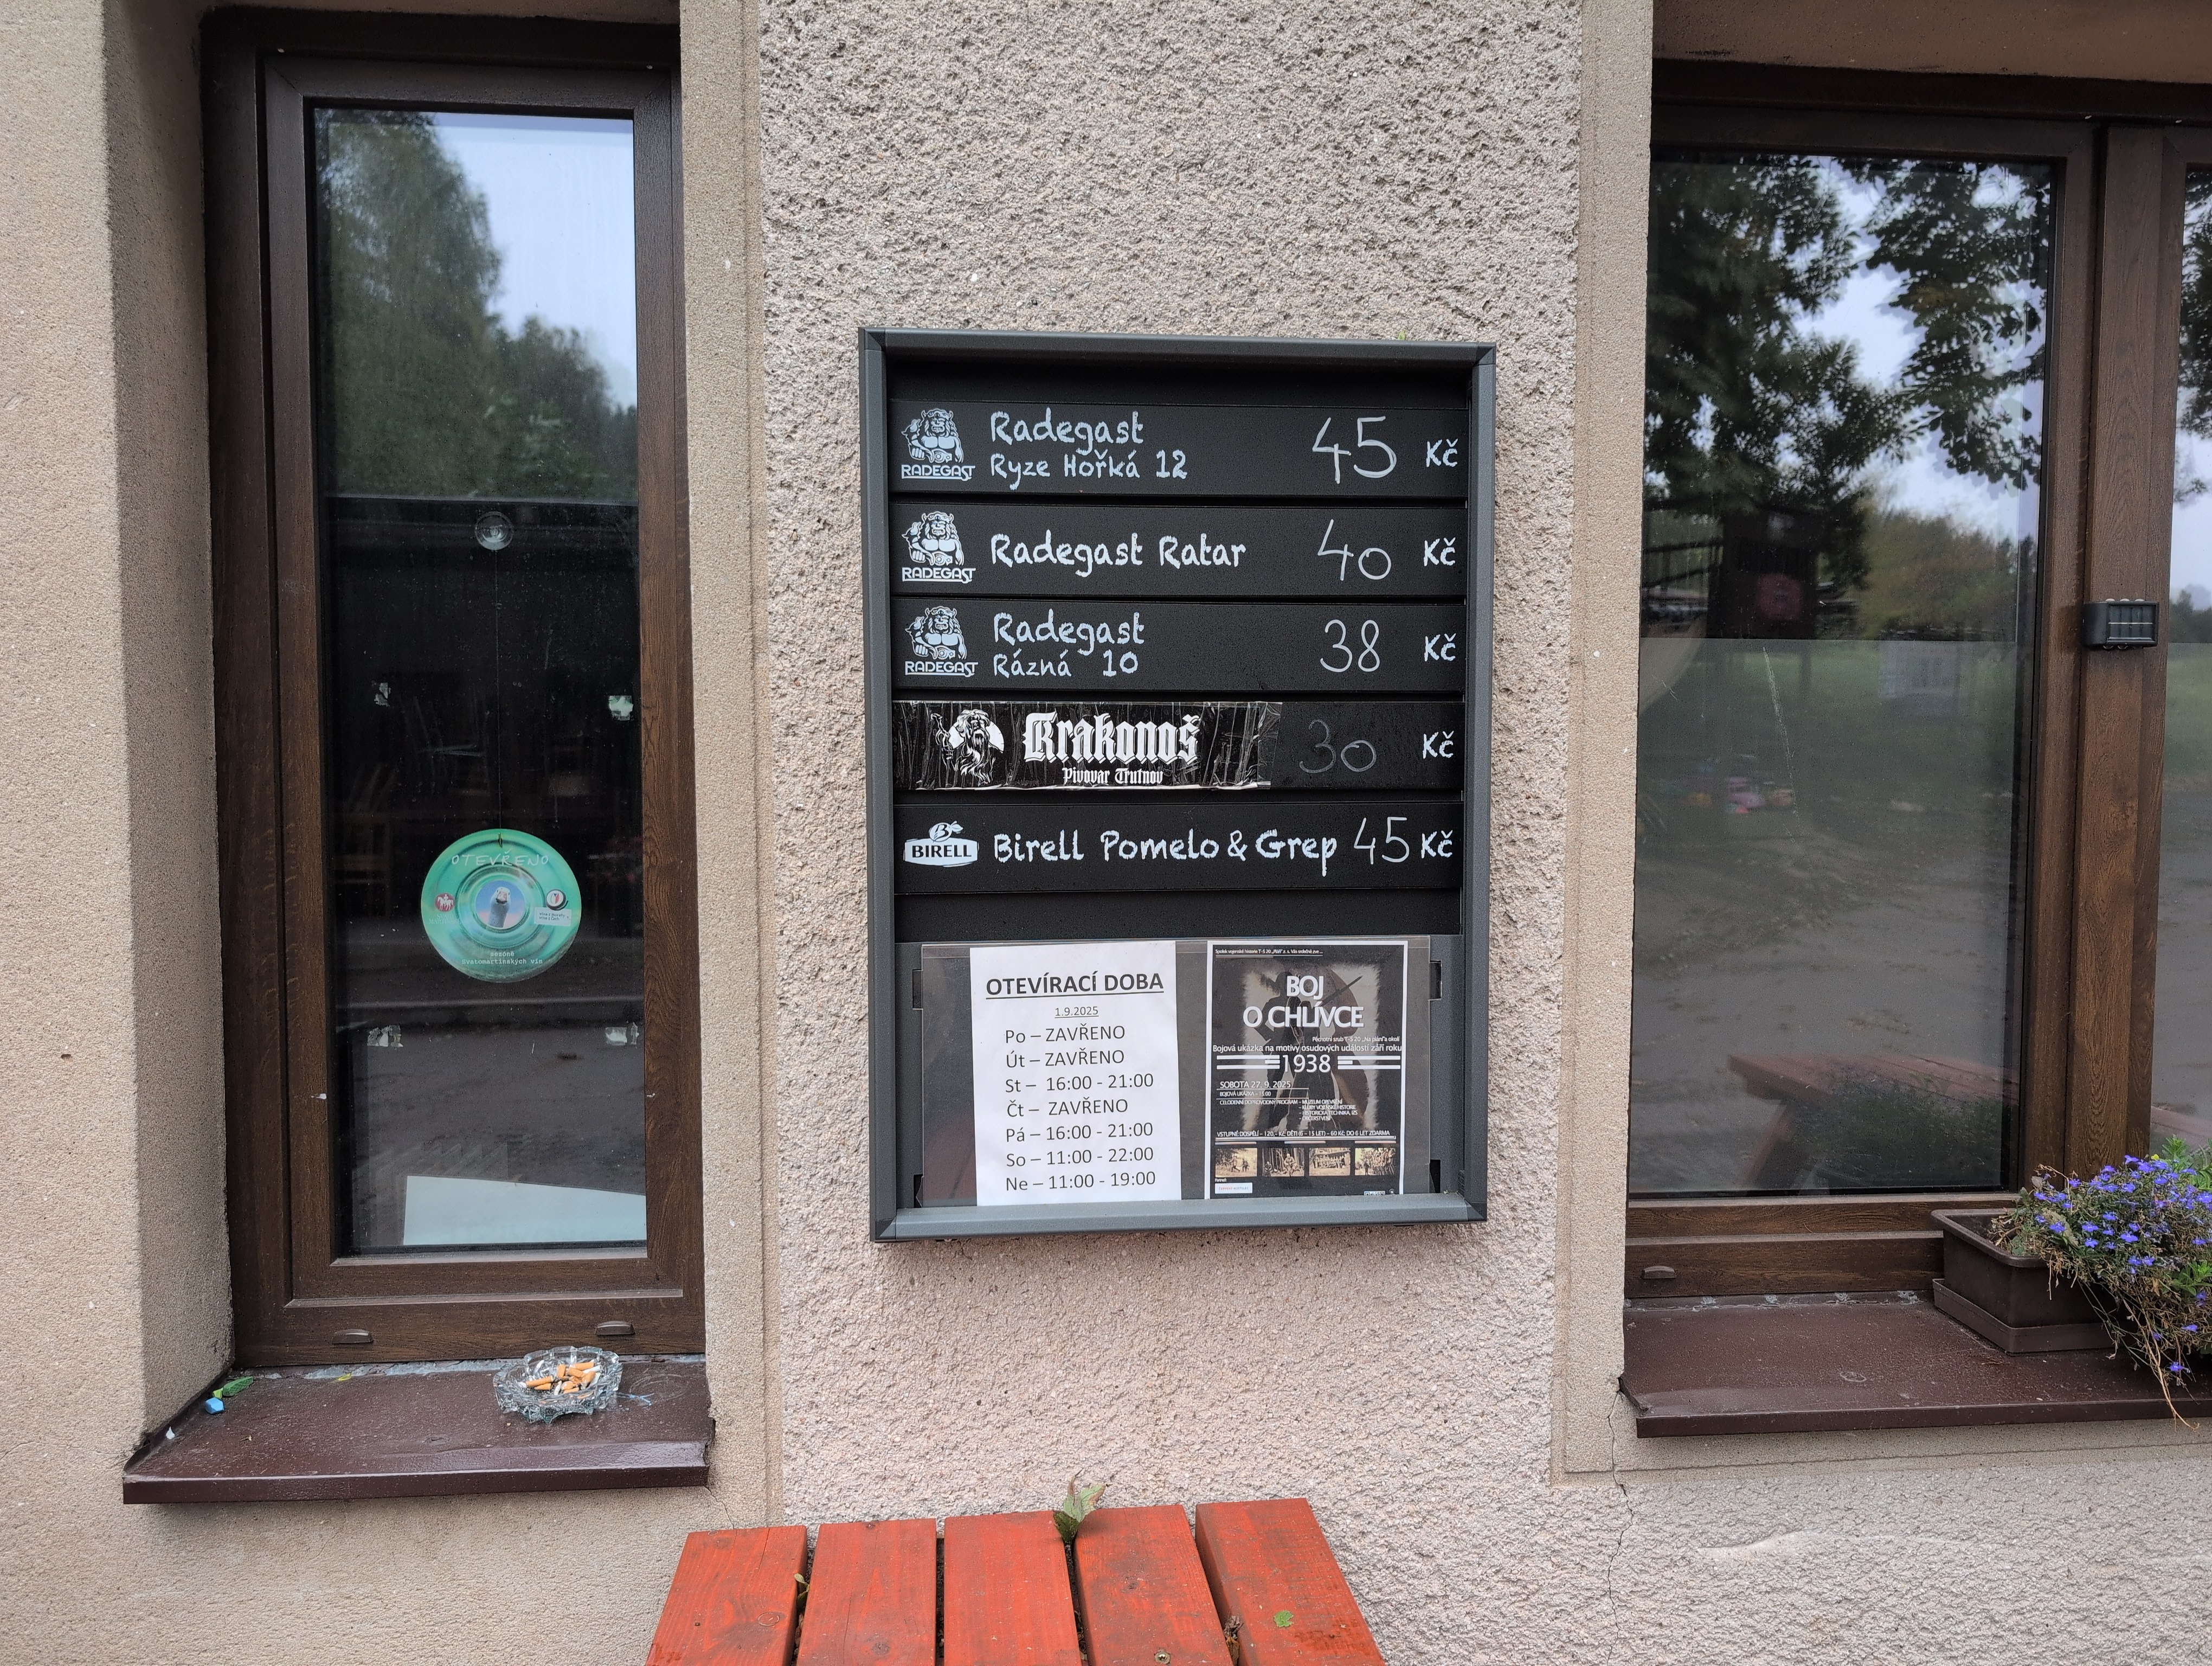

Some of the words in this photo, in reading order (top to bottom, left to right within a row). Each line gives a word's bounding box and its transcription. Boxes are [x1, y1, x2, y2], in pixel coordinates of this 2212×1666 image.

[991, 408, 1143, 456] Radegast
[1313, 416, 1396, 484] 45
[1426, 439, 1457, 468] Kč
[901, 465, 975, 480] RADEGAST
[991, 455, 1050, 490] Ryze
[1064, 448, 1141, 478] Hořká
[1156, 453, 1187, 478] 12
[991, 529, 1143, 577] Radegast
[1159, 532, 1246, 569] Ratar
[1317, 519, 1391, 581] 40
[1424, 538, 1455, 567] Kč
[902, 568, 976, 584] RADEGAST
[994, 610, 1144, 655] Radegast
[1320, 619, 1379, 672] 38
[1425, 634, 1456, 662] Kč
[905, 661, 978, 676] RADEGAST
[994, 651, 1071, 677] Rázná
[1103, 651, 1138, 676] 10
[1024, 711, 1201, 764] Krakonoš
[1300, 719, 1376, 773] 30
[1423, 732, 1454, 759] Kč
[1063, 767, 1109, 786] Pivovar
[1115, 767, 1163, 785] Trutnov
[912, 844, 972, 858] BIRELL
[994, 830, 1084, 862] Birell
[1102, 830, 1219, 861] Pomelo
[1229, 830, 1246, 860] &
[1256, 830, 1337, 876] Grep
[1354, 817, 1409, 864] 45
[1422, 832, 1453, 858] Kč
[452, 850, 549, 866] OTEVŘENO
[986, 971, 1097, 996] OTEVÍRACÍ
[1104, 973, 1163, 991] DOBA
[1287, 976, 1323, 999] BOJ
[1055, 1006, 1098, 1016] 1.9.2025
[1243, 1006, 1262, 1027] O
[1268, 1001, 1364, 1027] CHLÍVCE
[1005, 1030, 1025, 1043] Po
[1046, 1024, 1125, 1042] ZAVŘENO
[1006, 1050, 1025, 1068] Út
[1045, 1048, 1124, 1066] ZAVŘENO
[1213, 1044, 1236, 1053] Bojová
[1276, 1045, 1300, 1053] motivy
[1302, 1044, 1339, 1053] osudových
[1282, 1054, 1331, 1073] 1938
[1005, 1079, 1021, 1092] St
[1047, 1077, 1091, 1091] 16:00
[1108, 1074, 1153, 1088] 21:00
[1007, 1100, 1024, 1117] Čt
[1049, 1098, 1128, 1116] ZAVŘENO
[1006, 1127, 1025, 1142] Pá
[1046, 1125, 1091, 1140] 16:00
[1108, 1123, 1153, 1137] 21:00
[1006, 1154, 1025, 1167] So
[1047, 1150, 1091, 1165] 11:00
[1108, 1147, 1153, 1162] 22:00
[1006, 1178, 1027, 1191] Ne
[1049, 1175, 1094, 1189] 11:00
[1111, 1171, 1155, 1186] 19:00
